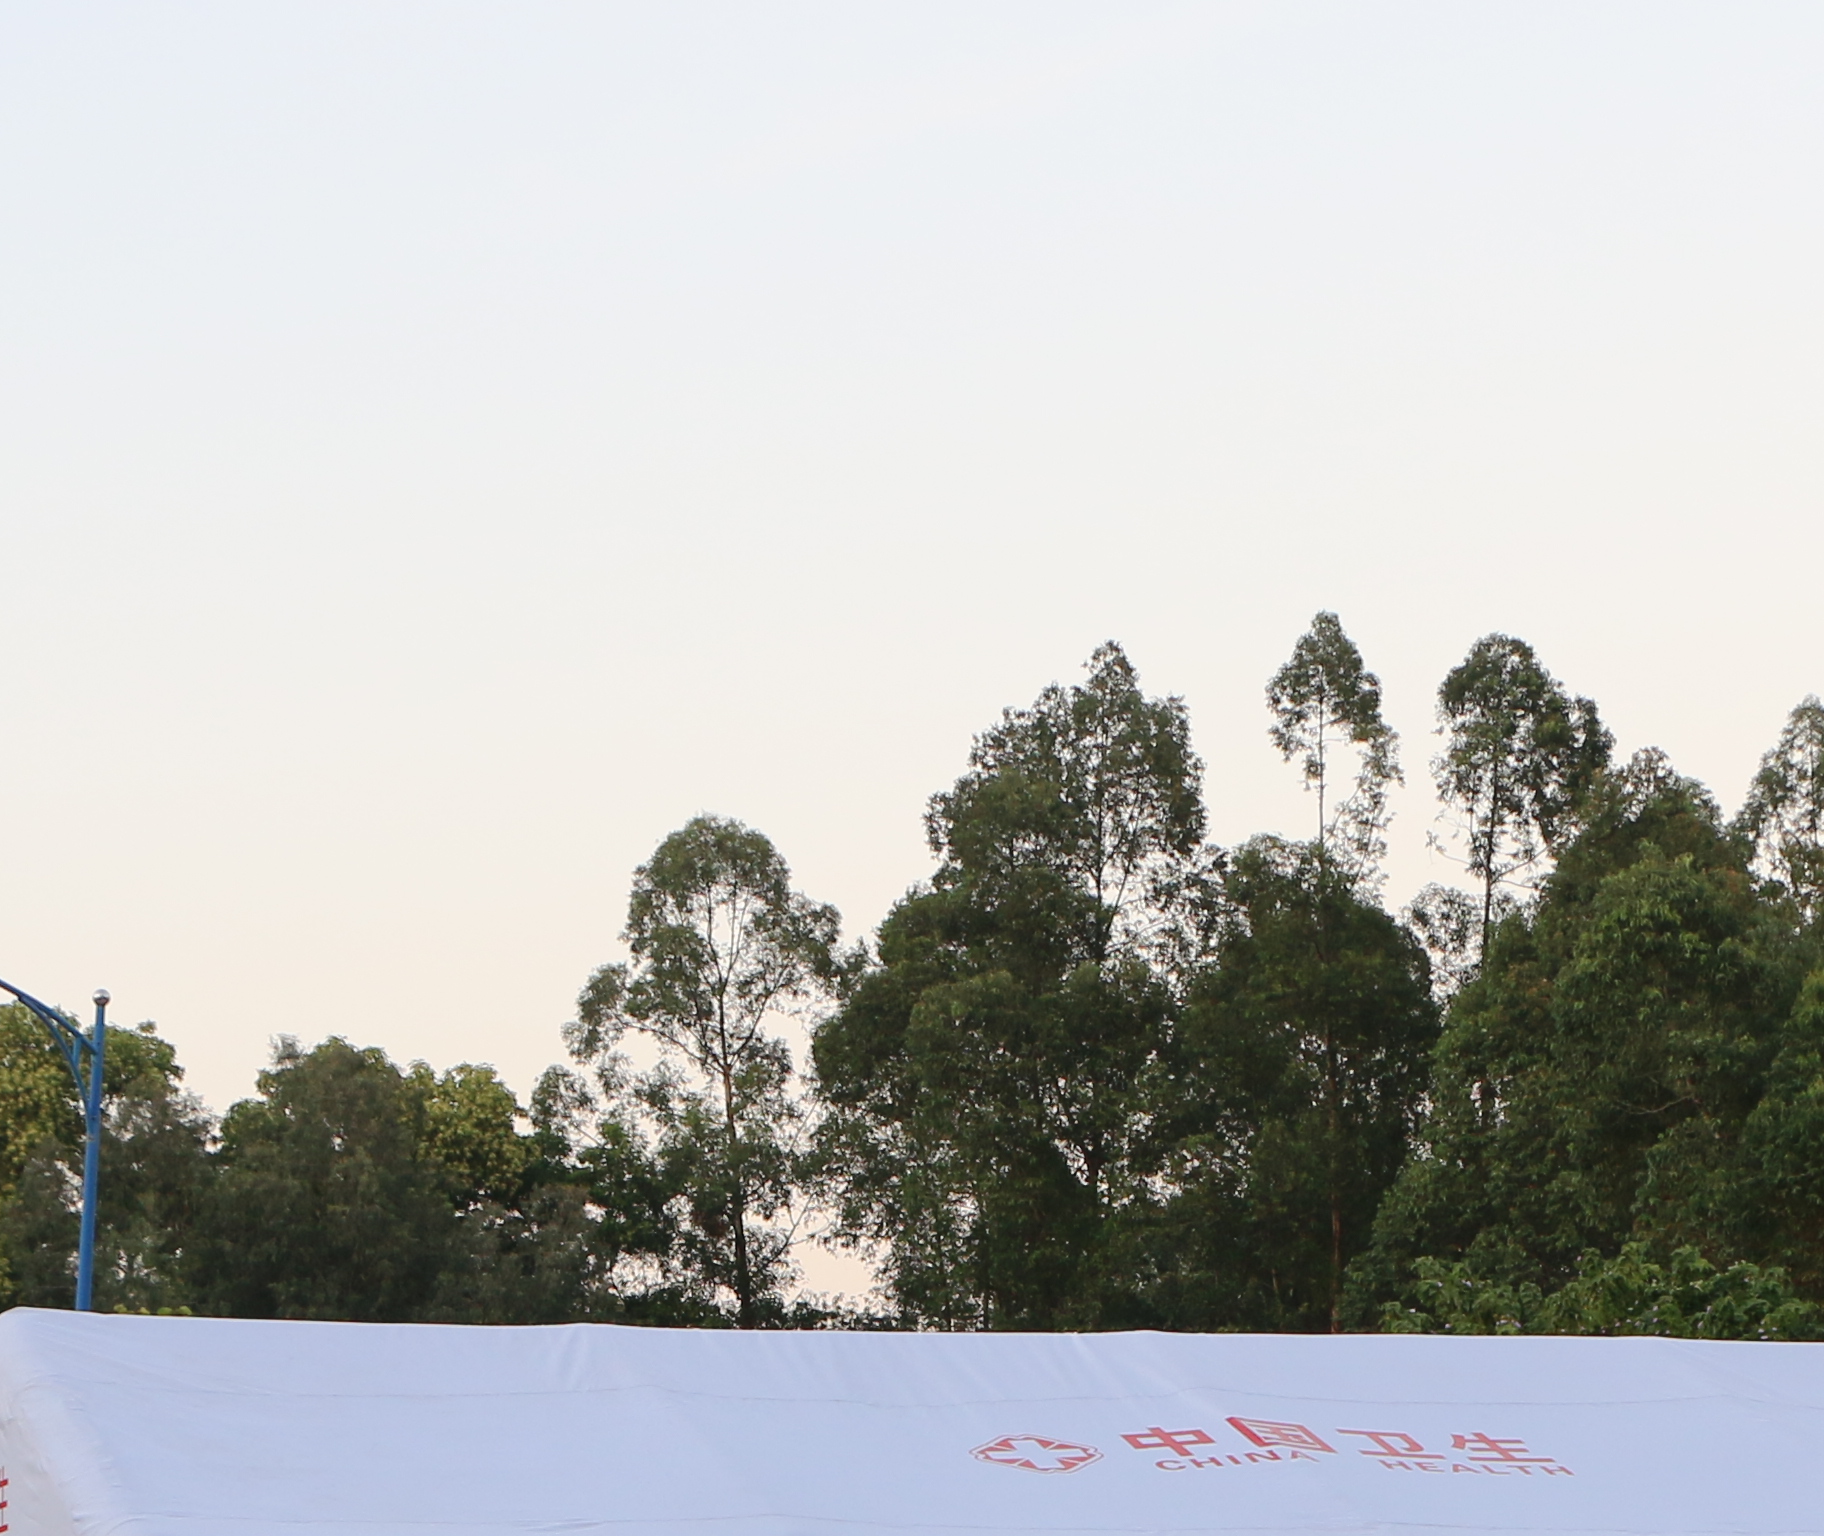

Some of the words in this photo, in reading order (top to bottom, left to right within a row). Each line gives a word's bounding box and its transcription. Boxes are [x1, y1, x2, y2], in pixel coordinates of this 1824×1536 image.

[1119, 1416, 1555, 1463] 中国卫生
[1154, 1449, 1320, 1471] CHINA
[1377, 1458, 1575, 1477] HEALTH
